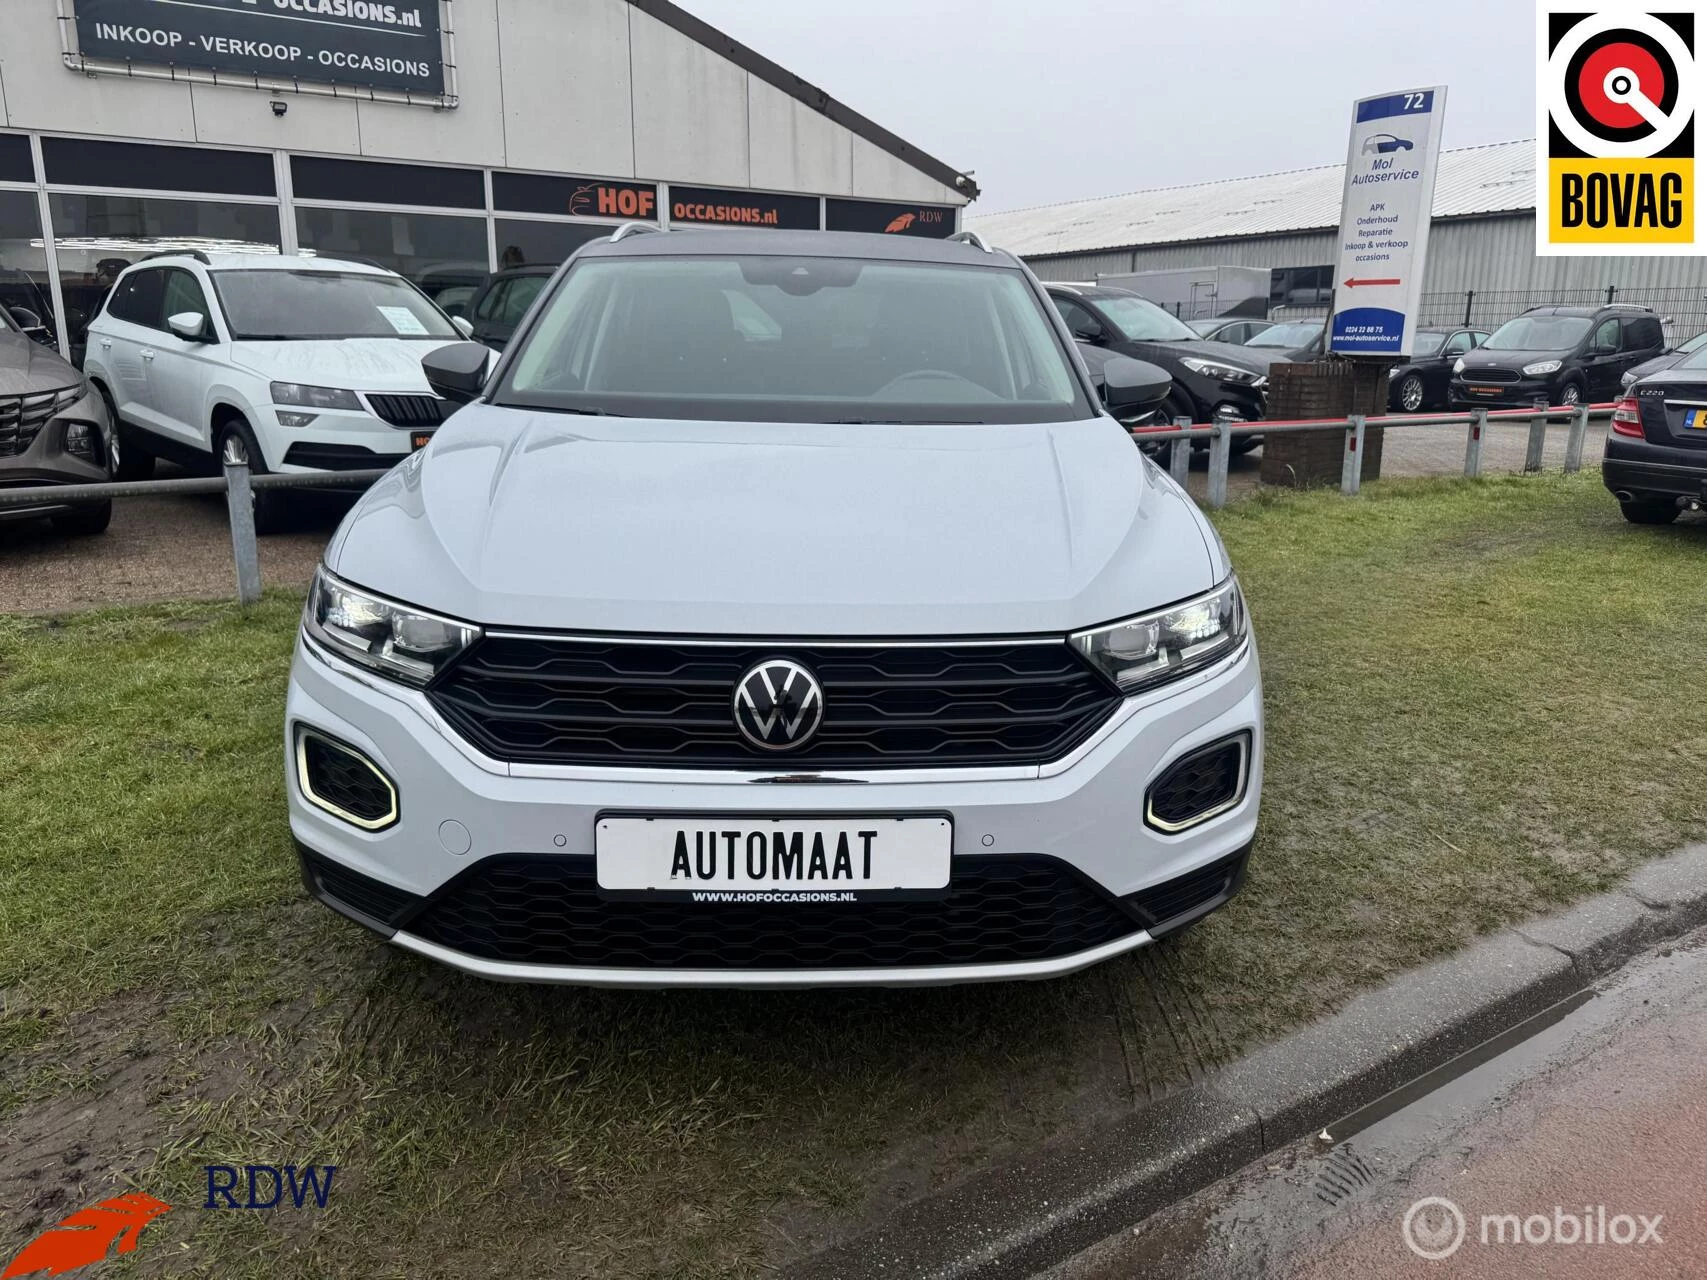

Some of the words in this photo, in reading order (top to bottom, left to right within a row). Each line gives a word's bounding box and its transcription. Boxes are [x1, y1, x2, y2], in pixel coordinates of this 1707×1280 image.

[95, 22, 182, 47] INKOOP
[199, 35, 302, 61] VERKOOP
[318, 50, 430, 77] OCCASIONS
[1404, 92, 1424, 110] 72
[1372, 157, 1394, 171] Mol
[1351, 169, 1419, 186] Autoservice
[597, 188, 654, 216] HOF
[673, 203, 778, 224] OCCASIONS.nl
[1370, 203, 1385, 211] APK
[919, 209, 943, 223] RDW
[1356, 214, 1399, 225] Onderhoud
[1358, 228, 1393, 238] Reparatie
[1375, 240, 1409, 248] verkoop
[1355, 253, 1390, 261] occasions
[670, 830, 878, 881] AUTOMAAT
[692, 892, 858, 903] WWW.HOFOCCASIONS.NL
